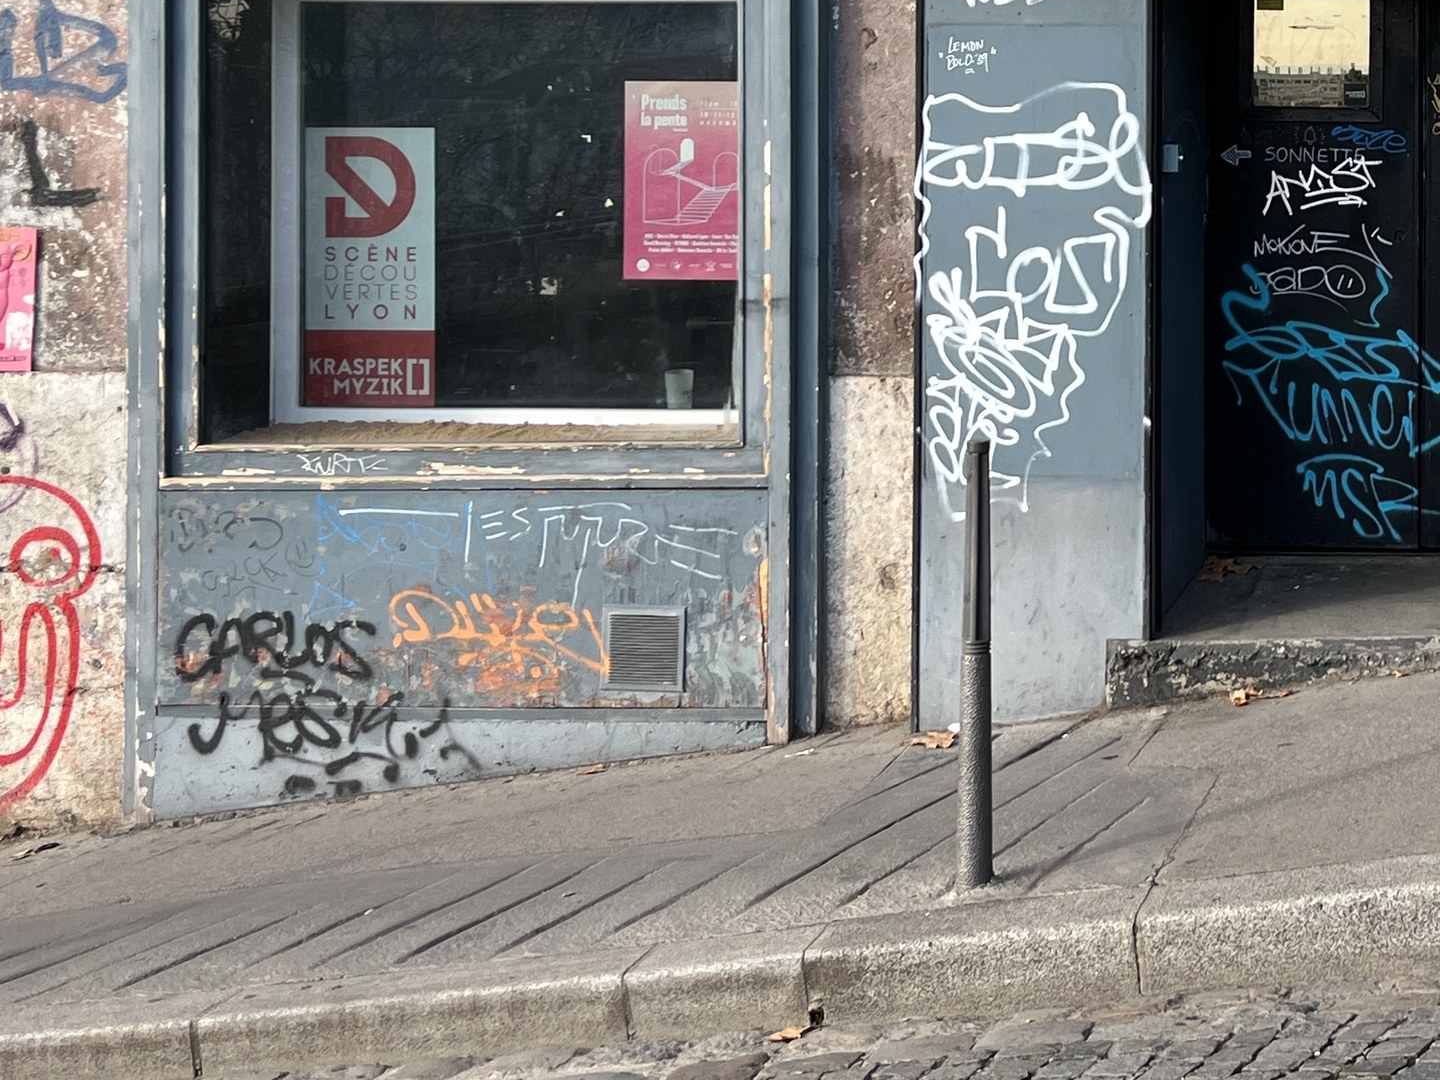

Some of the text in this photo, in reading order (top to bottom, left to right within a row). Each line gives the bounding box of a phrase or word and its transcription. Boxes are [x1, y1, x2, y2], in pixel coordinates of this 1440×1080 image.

[641, 93, 688, 111] Prends
[640, 111, 652, 126] la
[654, 113, 688, 131] pente
[1265, 146, 1366, 163] SONNETTE
[325, 244, 417, 262] SCÈNE
[325, 262, 417, 281] DÉCOU
[325, 284, 417, 300] VERTES
[325, 303, 417, 320] LYON
[309, 358, 404, 375] KRASPEK
[333, 378, 404, 395] MYZIK
